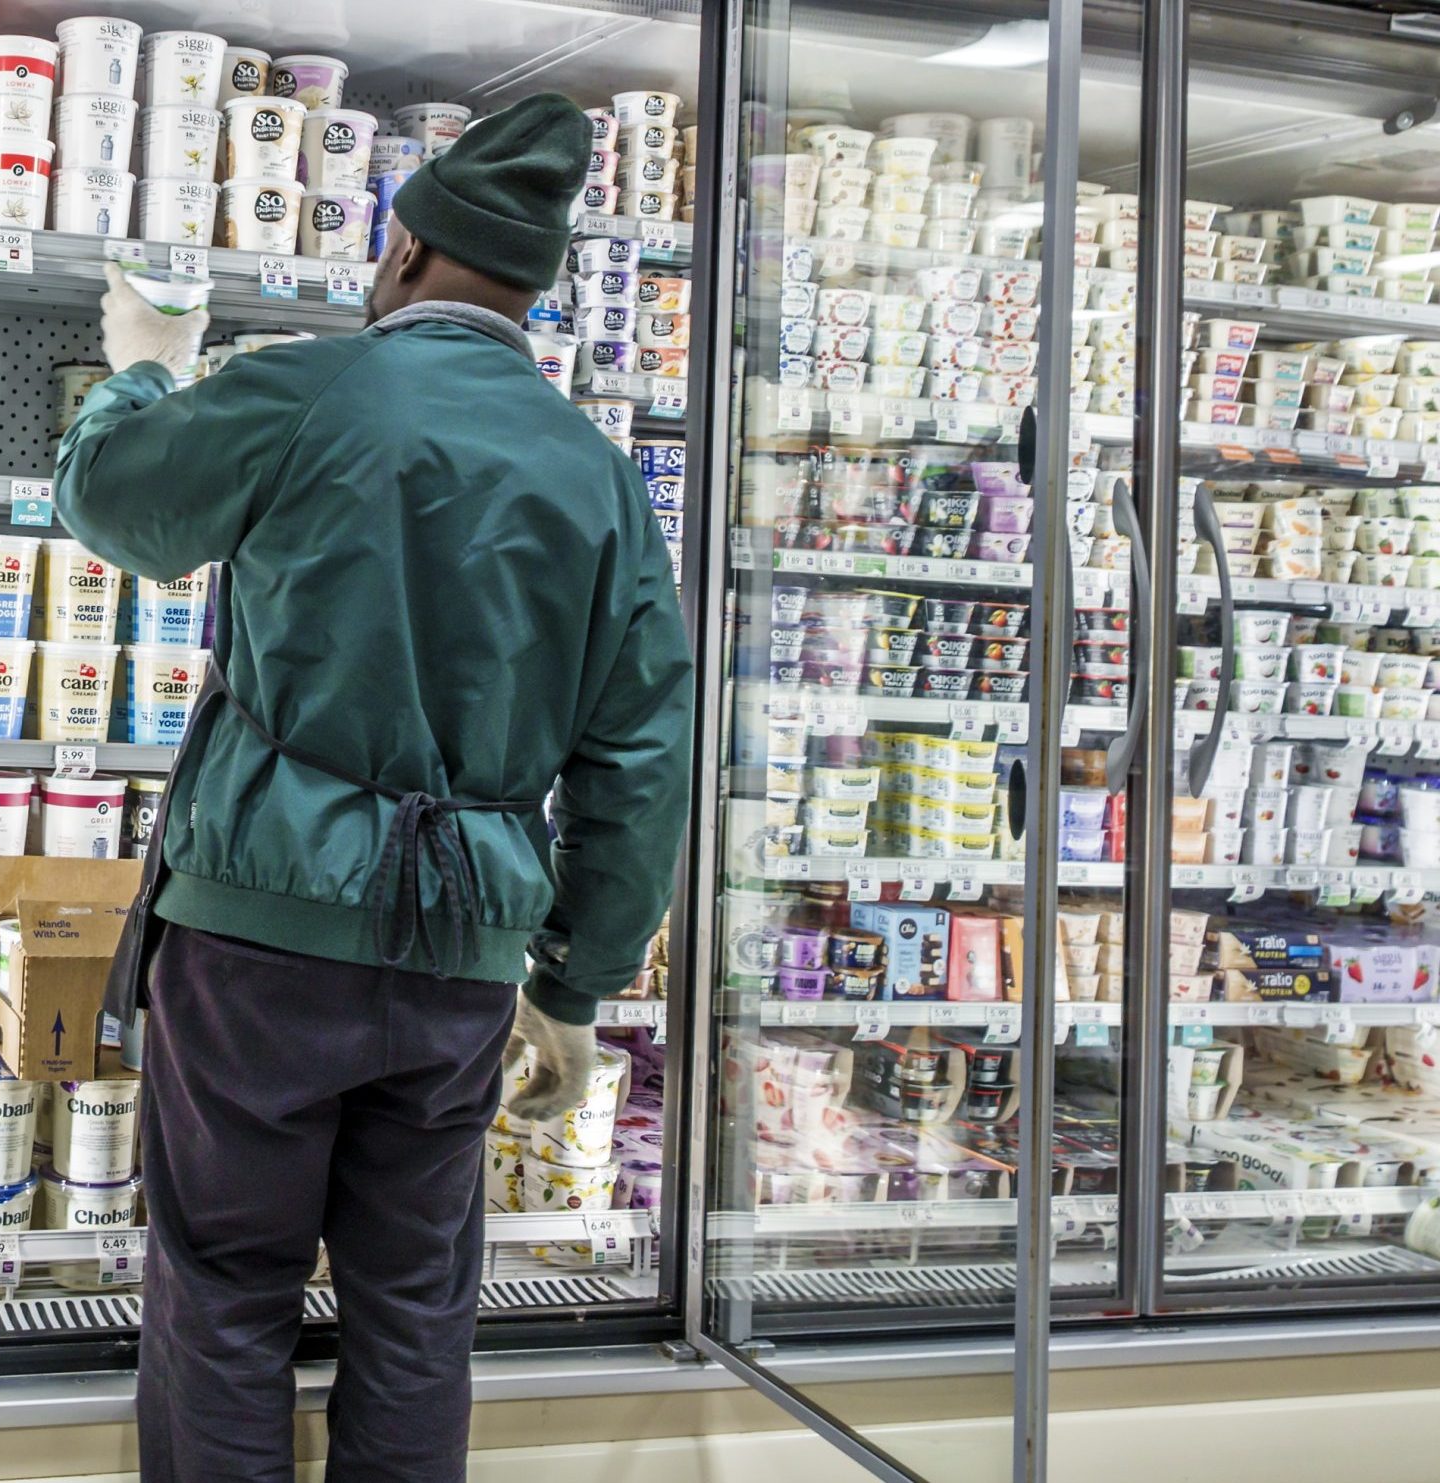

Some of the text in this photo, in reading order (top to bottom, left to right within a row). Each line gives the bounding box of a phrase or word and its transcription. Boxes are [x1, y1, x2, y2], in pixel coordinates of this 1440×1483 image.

[237, 64, 257, 77] SO
[256, 112, 279, 127] SO
[328, 125, 351, 140] SO
[259, 192, 283, 207] SO
[317, 203, 341, 218] SO
[0, 235, 21, 245] 3.09
[175, 252, 196, 263] 5.29
[263, 260, 284, 271] 6.29
[329, 266, 350, 276] 6.29
[62, 749, 84, 760] 5.99
[39, 920, 71, 929] Handle
[34, 930, 79, 939] With Care
[1267, 973, 1293, 986] ratio
[67, 1097, 137, 1116] Chobani
[591, 1220, 611, 1231] 6.49
[102, 1239, 127, 1250] 6.49
